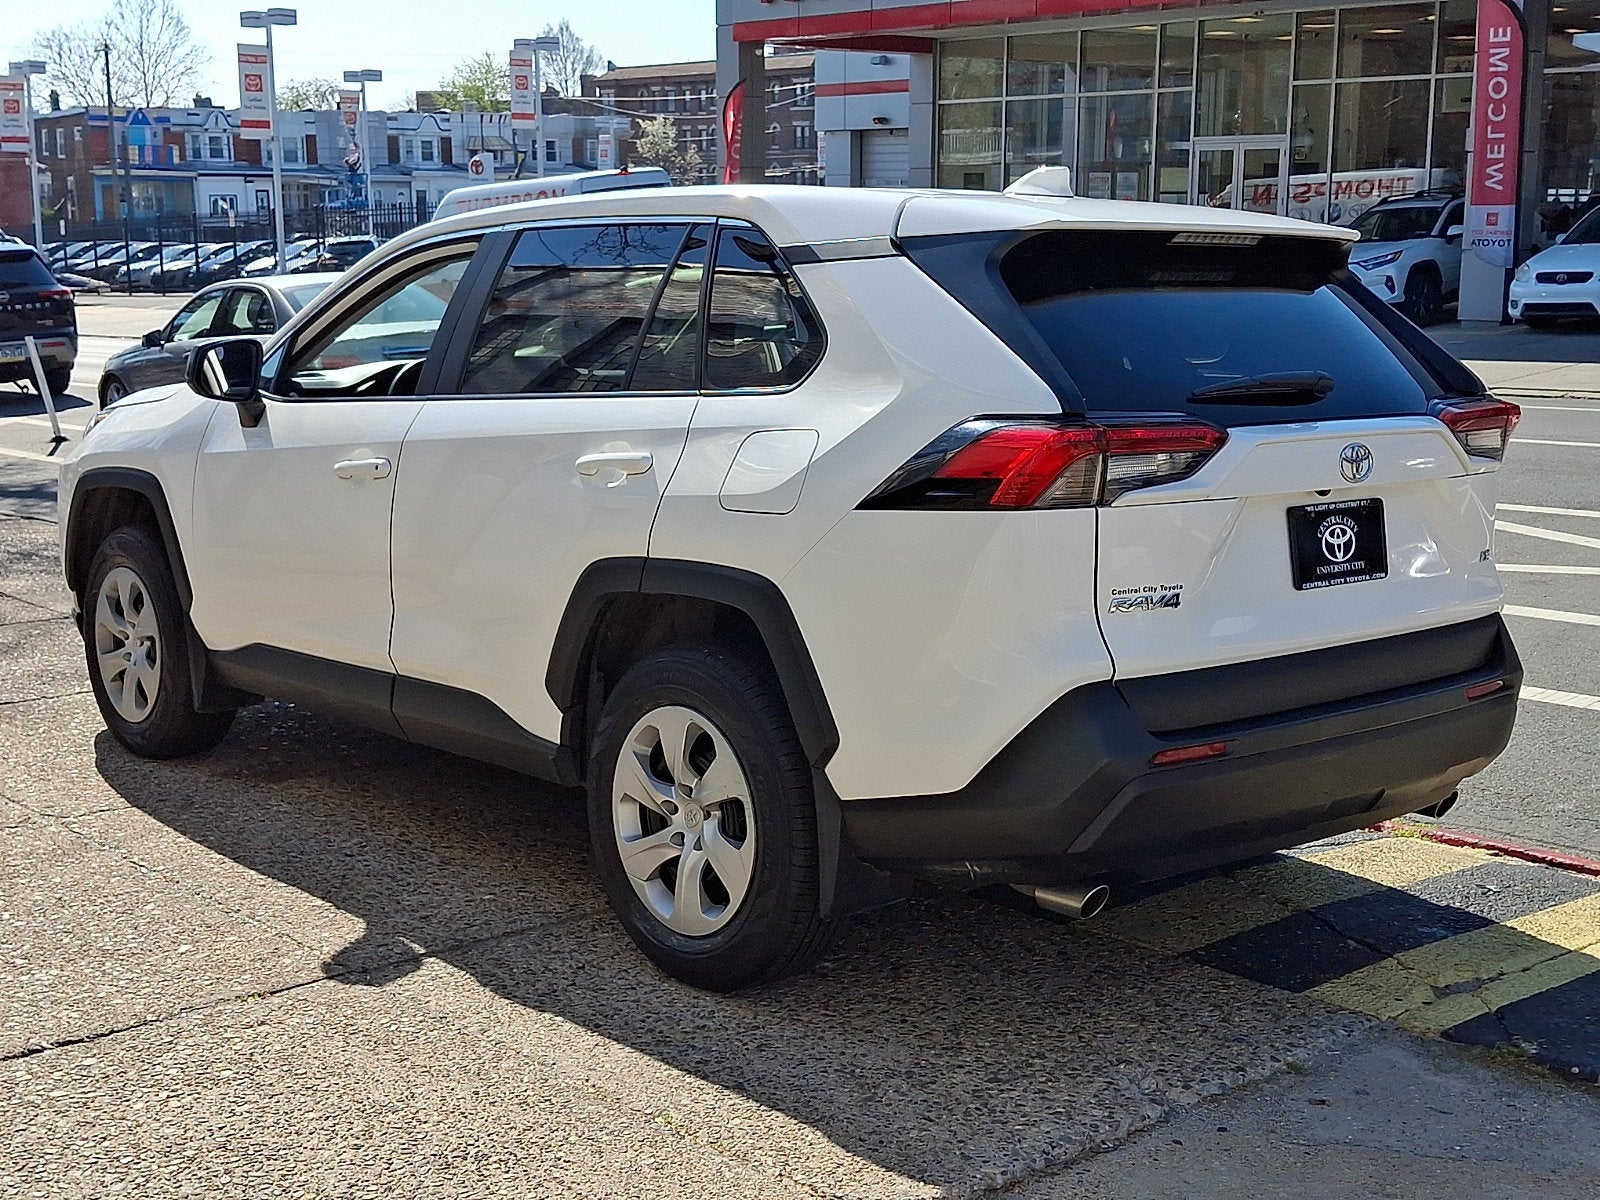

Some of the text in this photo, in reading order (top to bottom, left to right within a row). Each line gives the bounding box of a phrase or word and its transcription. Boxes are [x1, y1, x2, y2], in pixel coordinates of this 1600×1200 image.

[1317, 514, 1359, 538] CENTRAL CITY
[1317, 561, 1366, 575] UNIVERSITY CITY
[1302, 580, 1330, 589] CENTRAL
[1346, 574, 1370, 583] TOYOTA
[1111, 583, 1184, 596] Central City Toyota
[1108, 592, 1181, 614] RAV4
